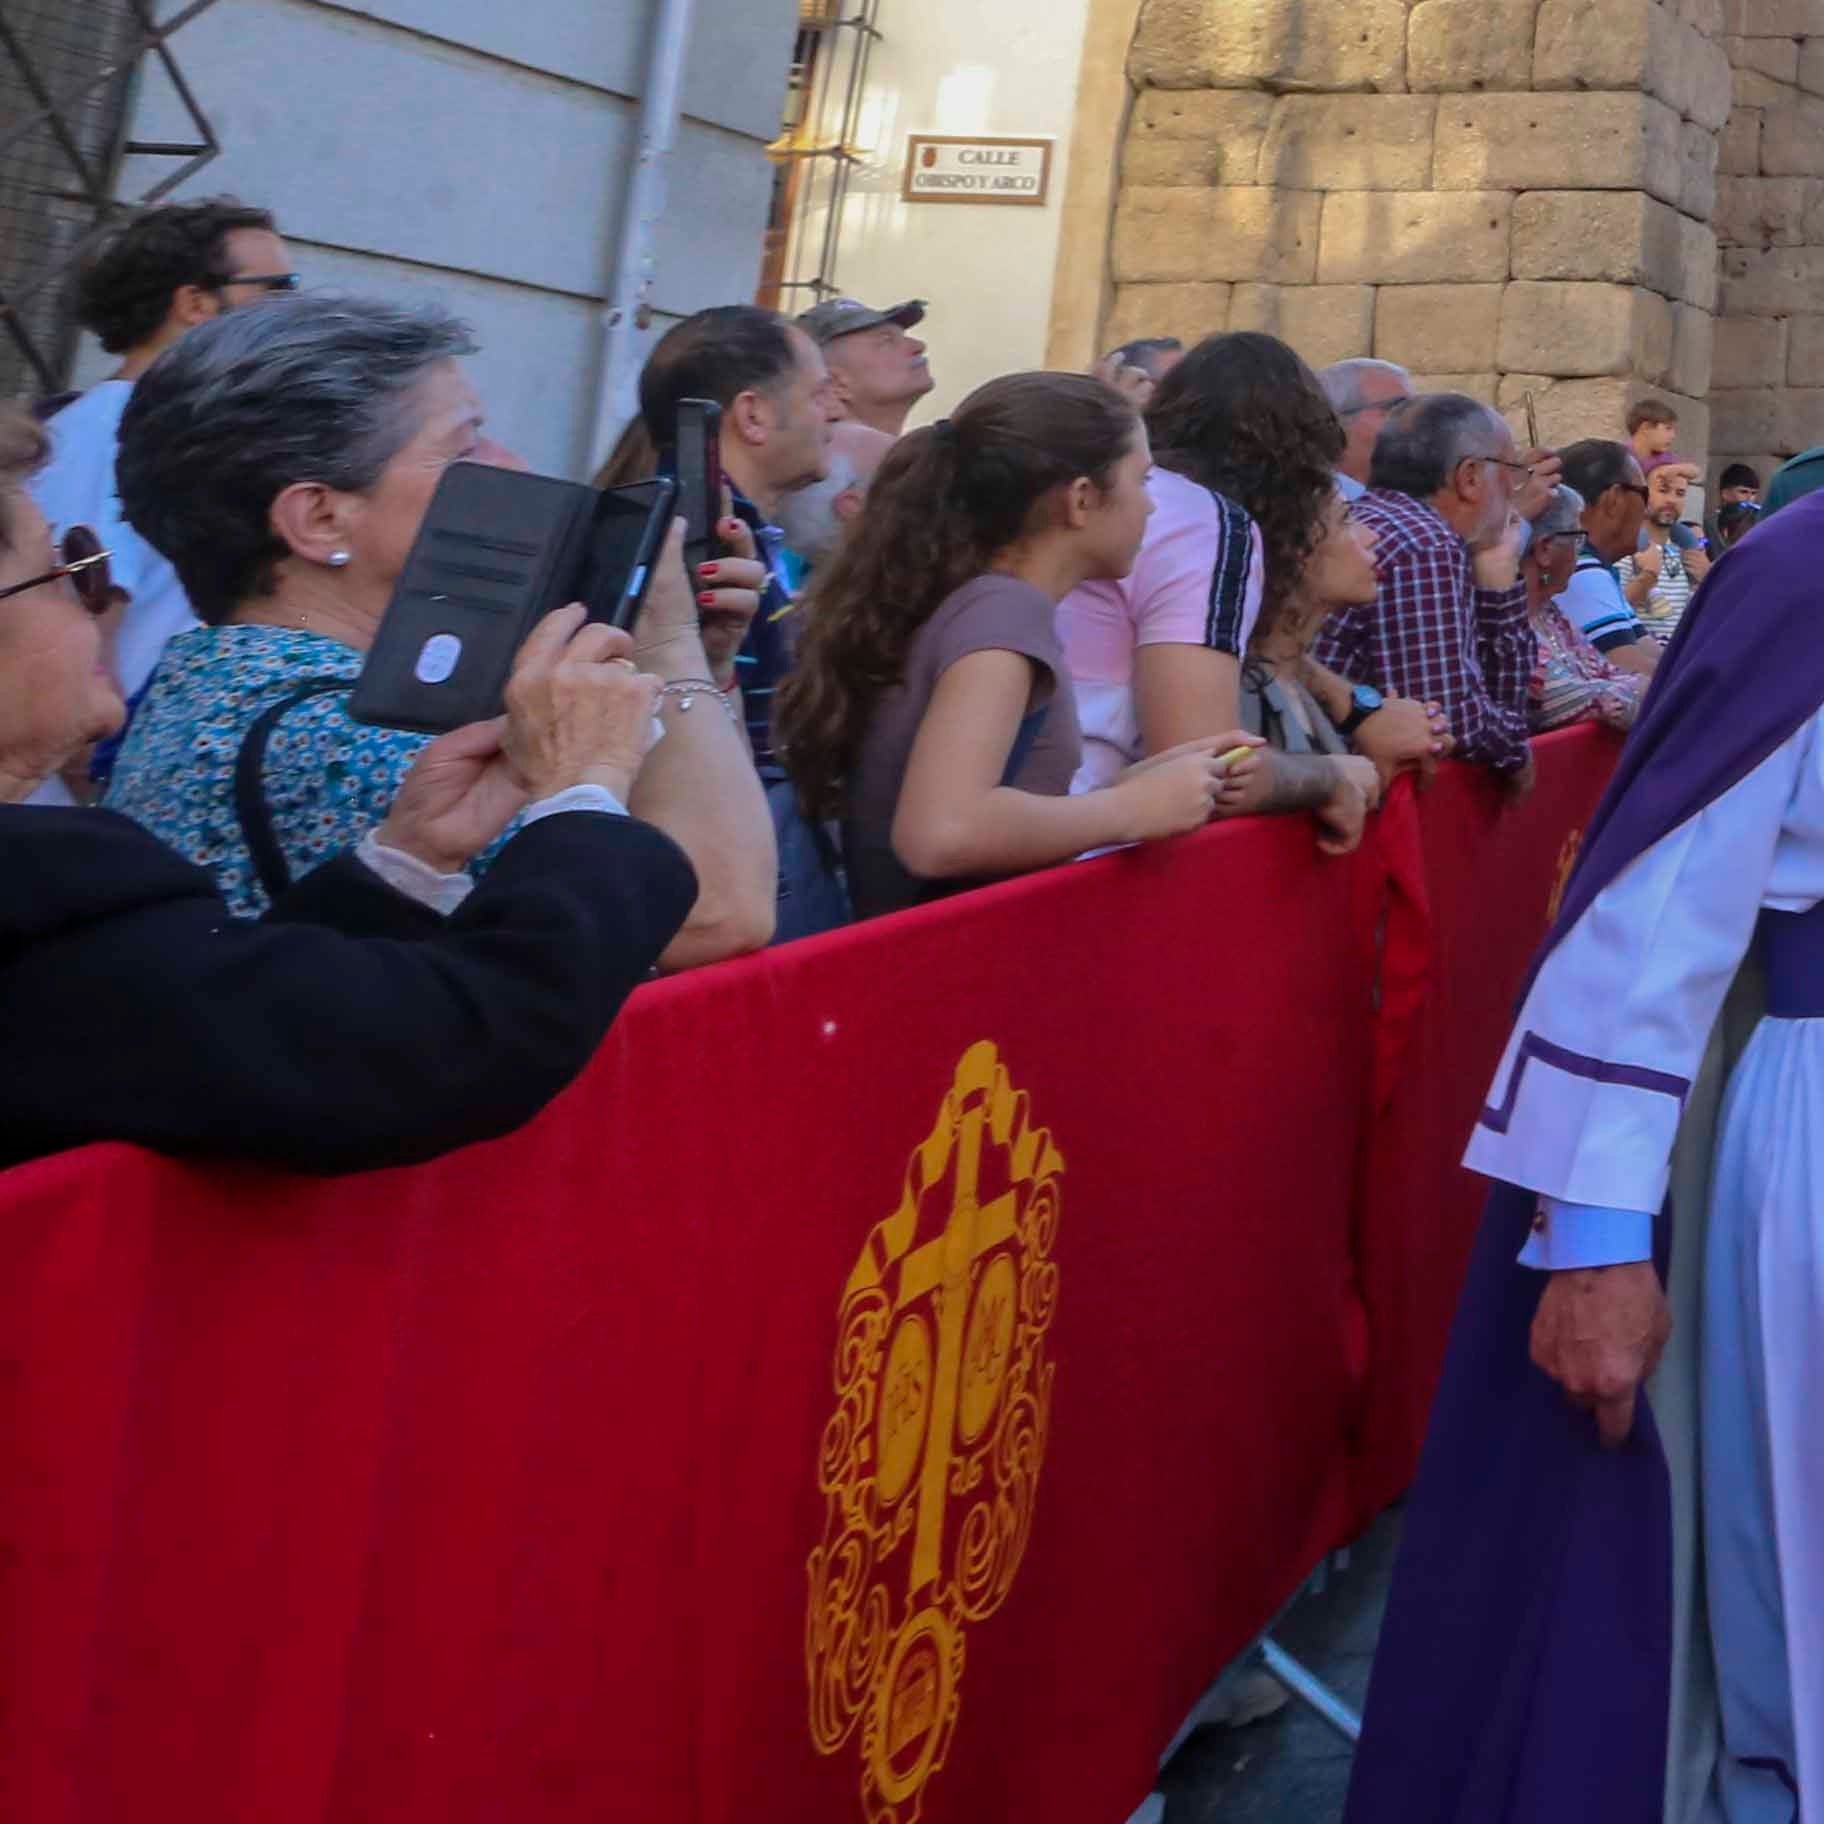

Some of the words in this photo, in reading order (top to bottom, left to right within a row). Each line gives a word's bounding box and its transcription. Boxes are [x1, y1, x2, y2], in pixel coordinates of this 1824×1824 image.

[958, 150, 1021, 165] CALLE
[915, 174, 976, 189] OBISPO
[977, 175, 989, 189] Y
[991, 176, 1036, 190] ARCO
